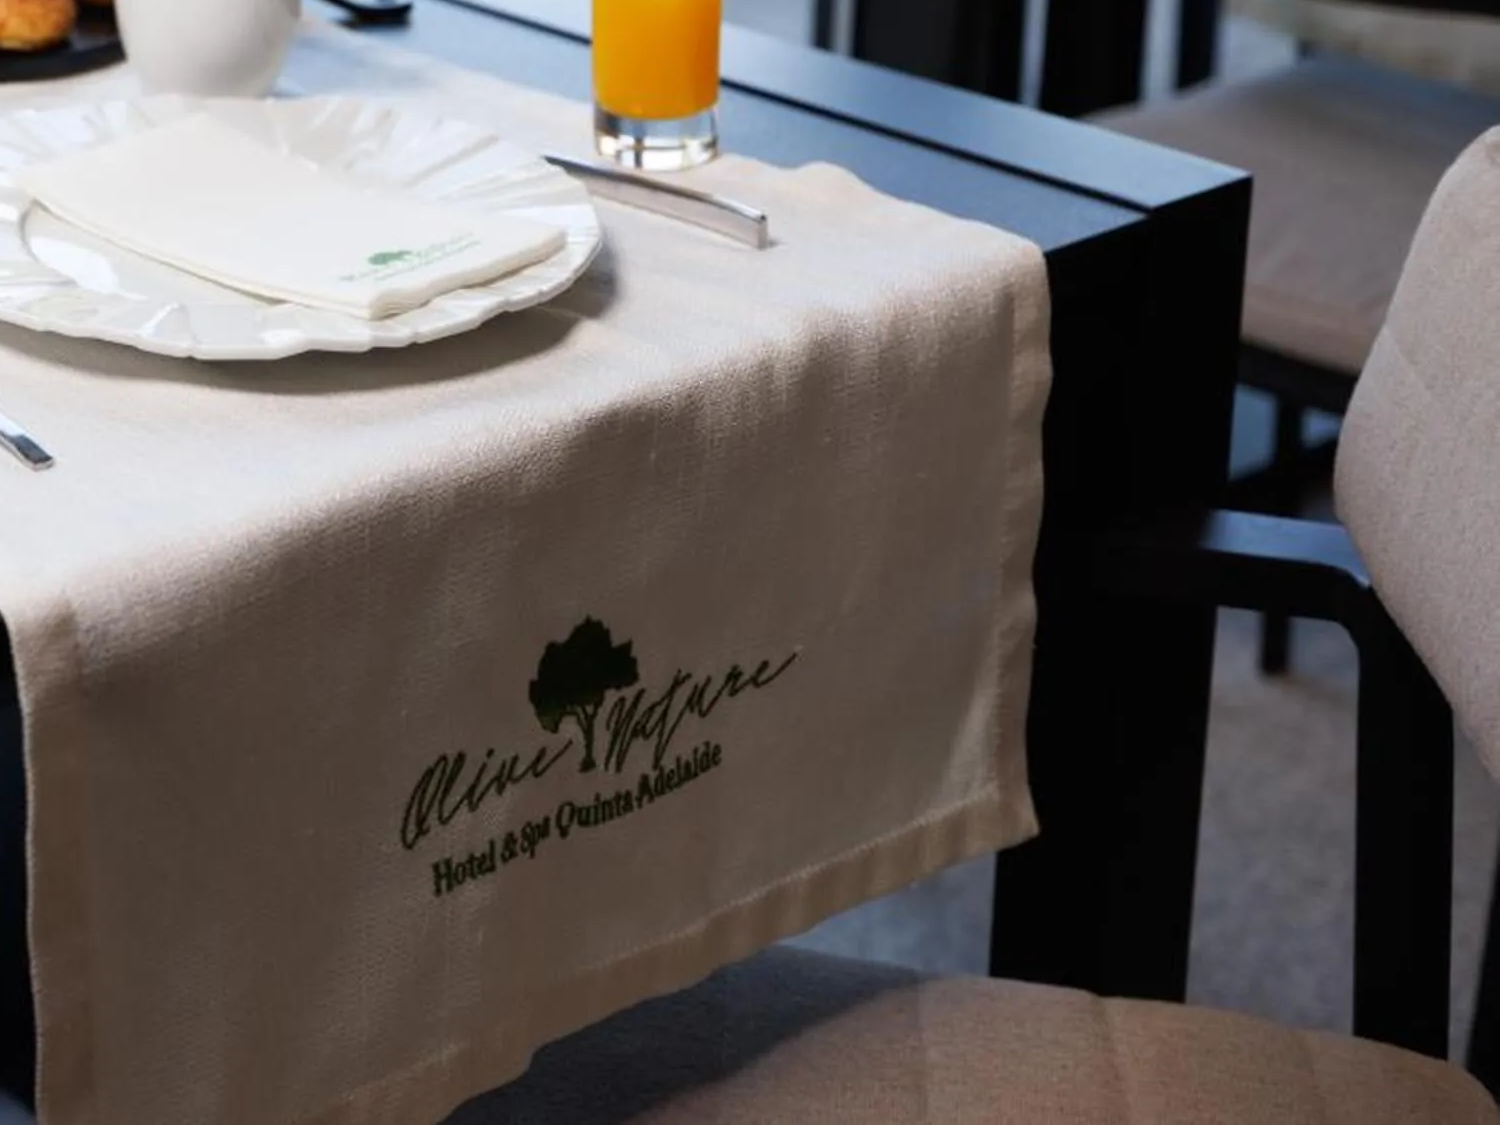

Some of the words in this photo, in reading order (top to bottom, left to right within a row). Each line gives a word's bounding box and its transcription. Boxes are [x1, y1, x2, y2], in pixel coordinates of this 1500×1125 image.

[401, 739, 573, 850] Olive
[604, 649, 800, 774] Nature
[431, 838, 497, 898] Hotel
[500, 830, 519, 864] &
[520, 815, 551, 860] Spa
[554, 791, 634, 840] Quinta
[634, 740, 723, 809] Adelaide
